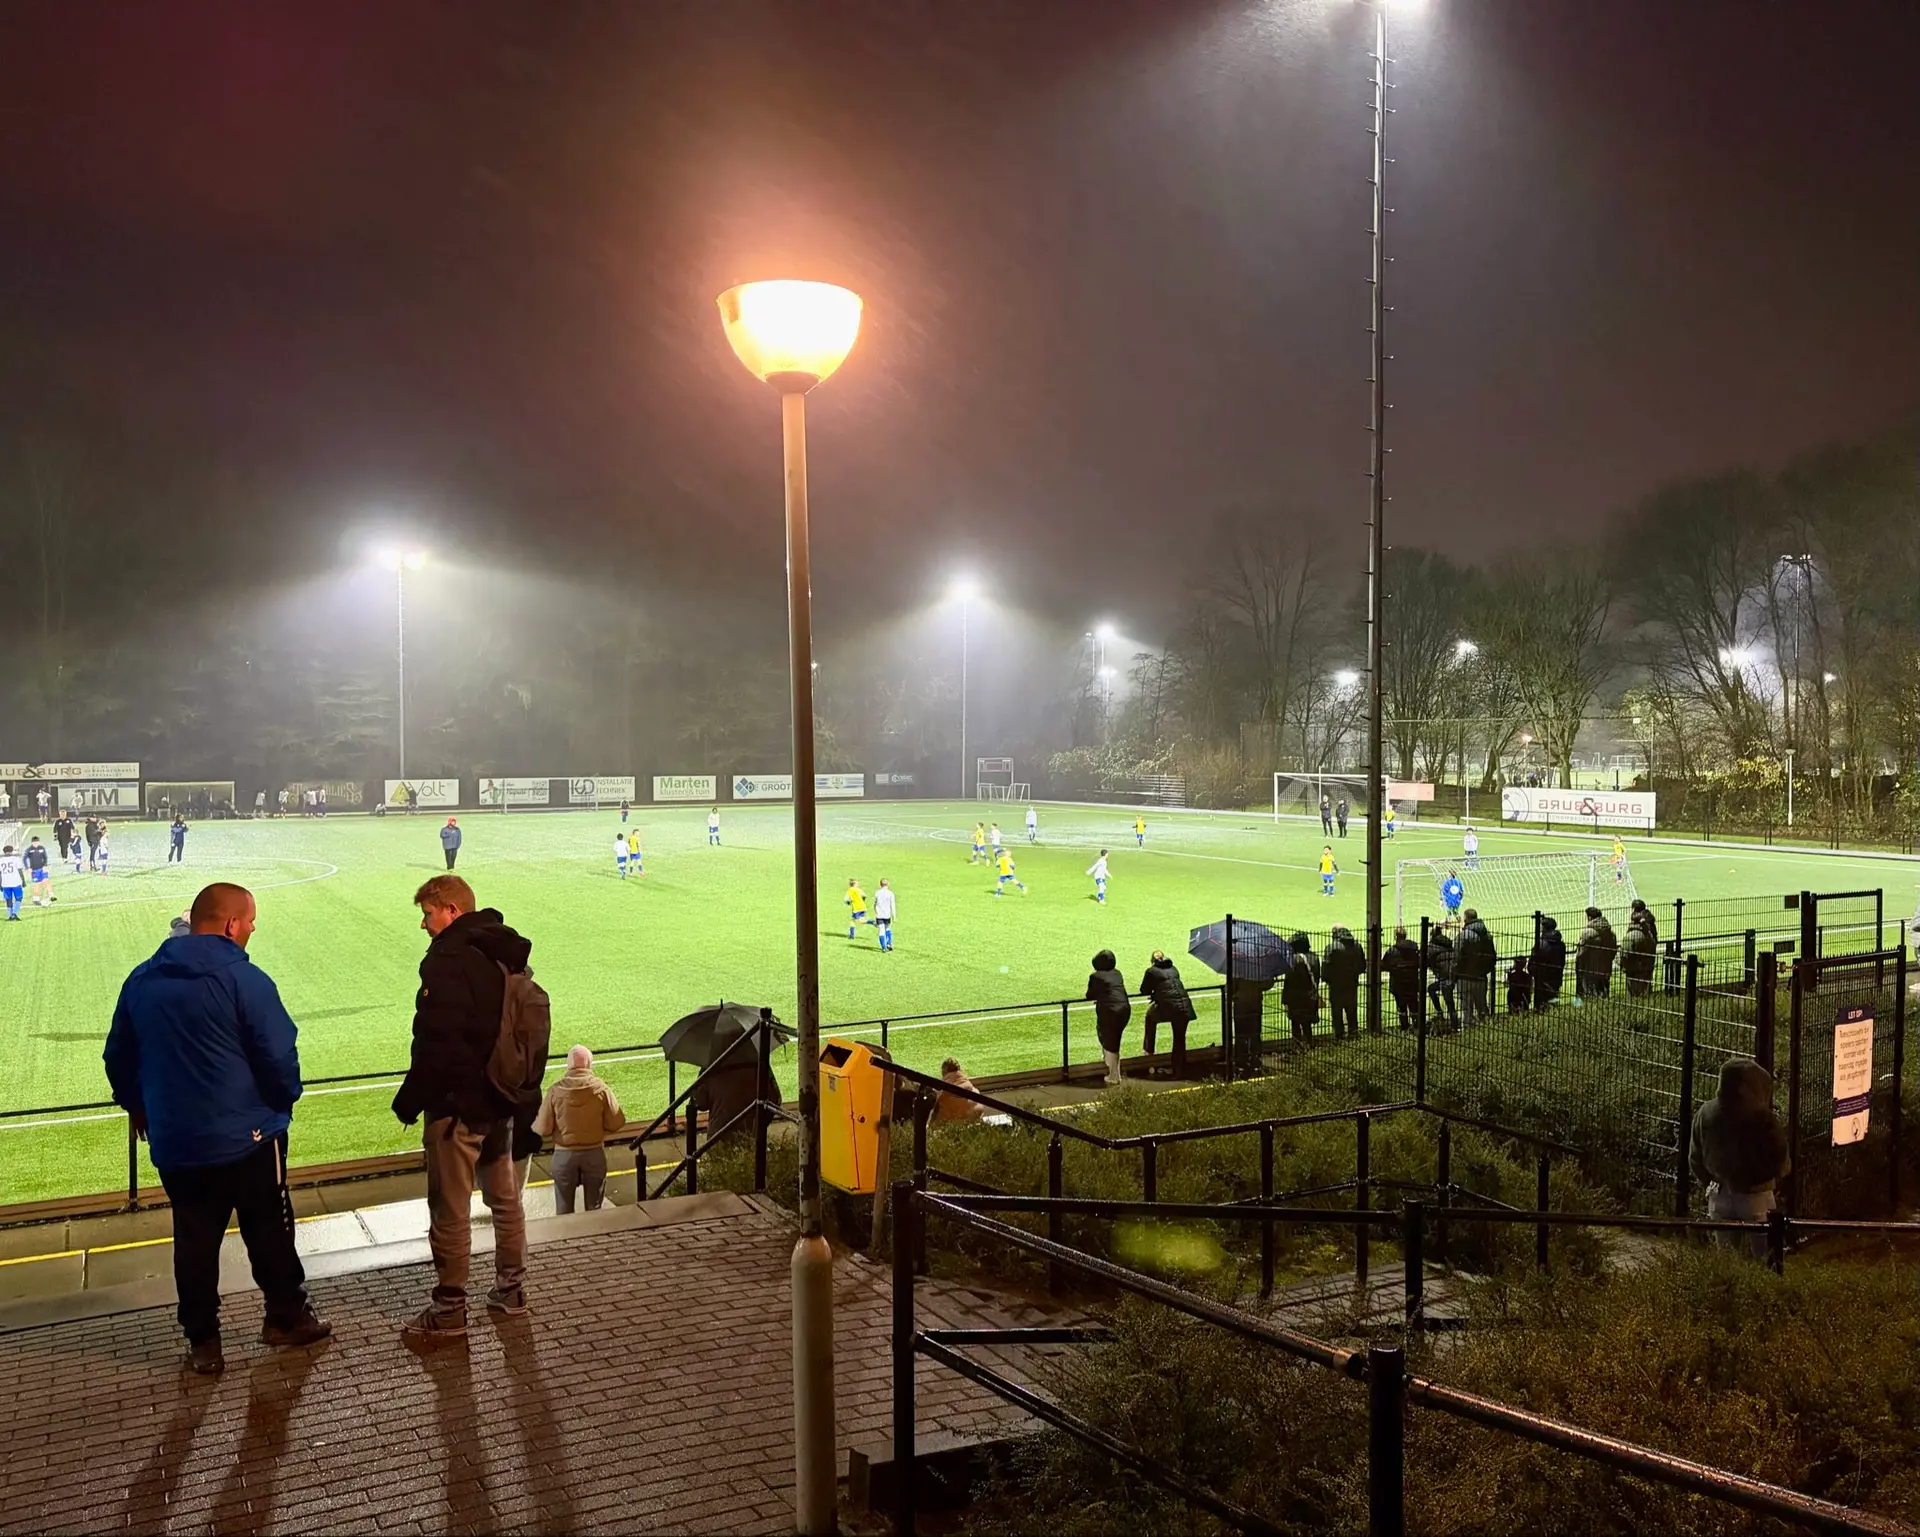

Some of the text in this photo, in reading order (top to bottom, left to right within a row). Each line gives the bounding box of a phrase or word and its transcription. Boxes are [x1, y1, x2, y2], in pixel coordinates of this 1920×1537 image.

[660, 776, 710, 788] Marten
[761, 783, 791, 791] GROOT
[75, 788, 119, 805] TiM
[1, 862, 14, 874] 25
